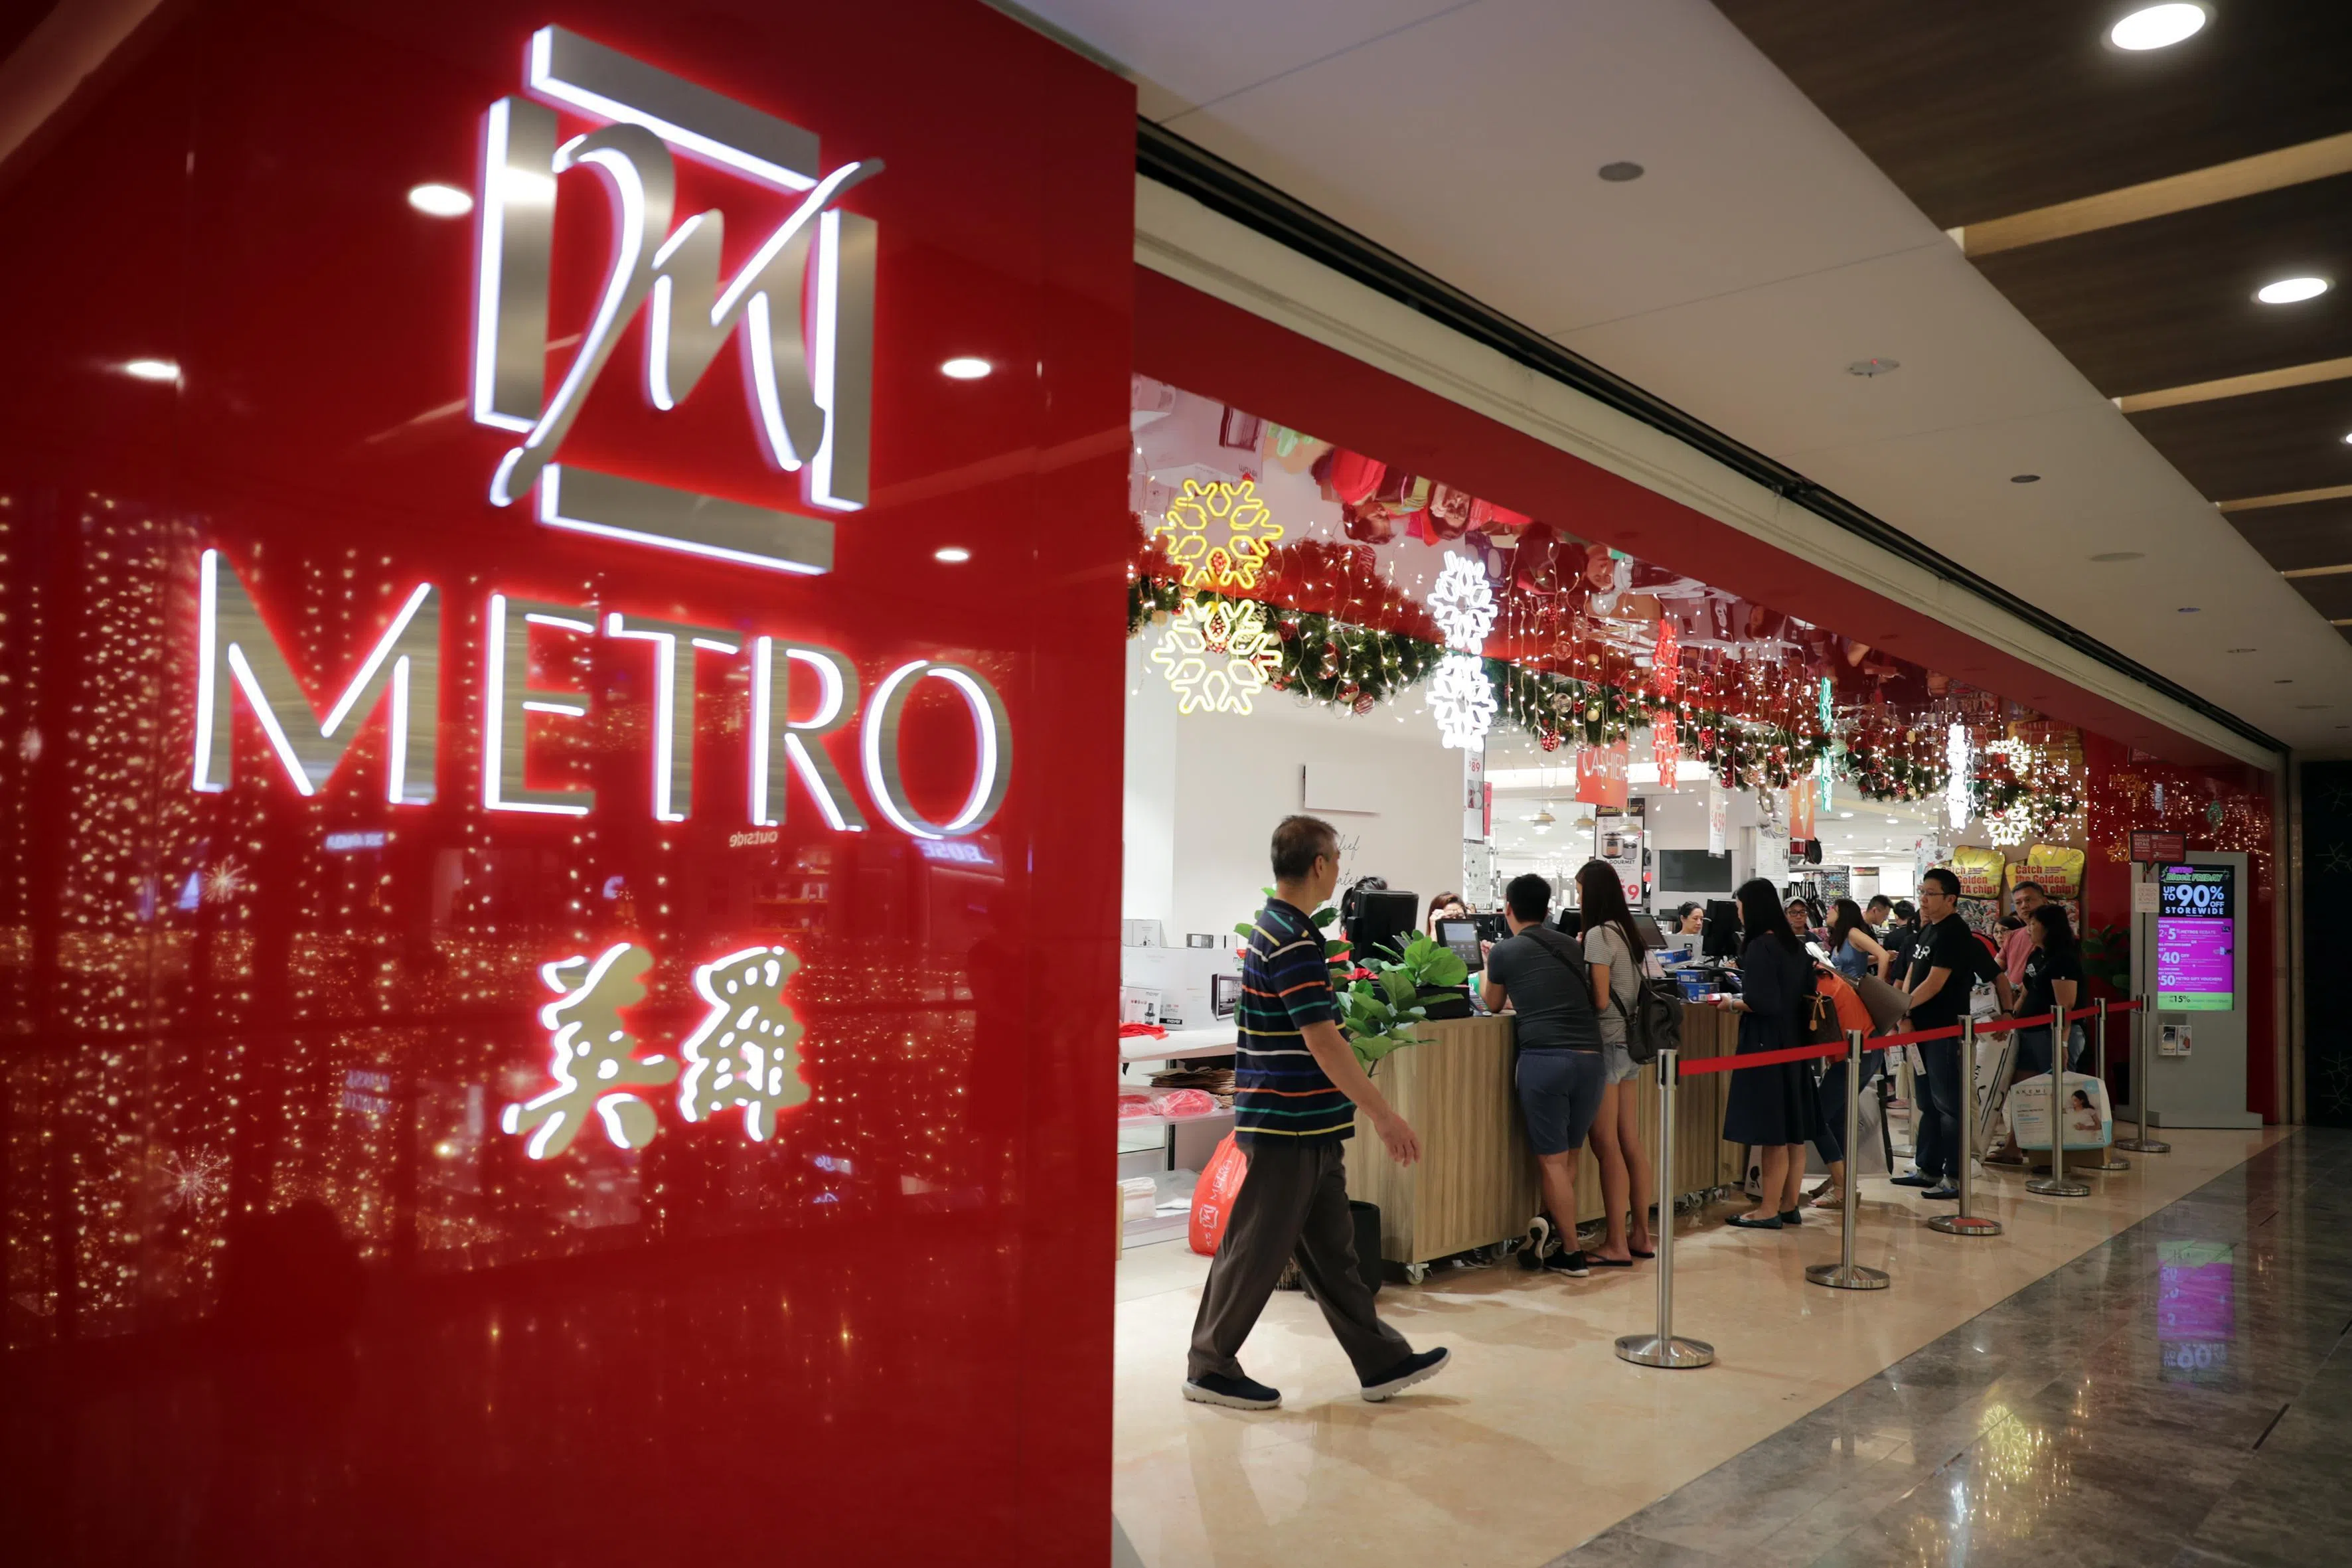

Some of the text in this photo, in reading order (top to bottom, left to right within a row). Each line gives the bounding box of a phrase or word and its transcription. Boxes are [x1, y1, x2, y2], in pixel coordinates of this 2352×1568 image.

[192, 548, 1013, 840] METRO
[1583, 748, 1626, 781] CASHIER
[2015, 865, 2043, 874] Catch
[1958, 876, 1988, 884] Golden
[2033, 875, 2066, 884] Golden
[1973, 885, 1997, 894] chip!
[2051, 884, 2077, 895] chip!
[2175, 884, 2225, 907] 90%
[1209, 1159, 1233, 1201] METRO
